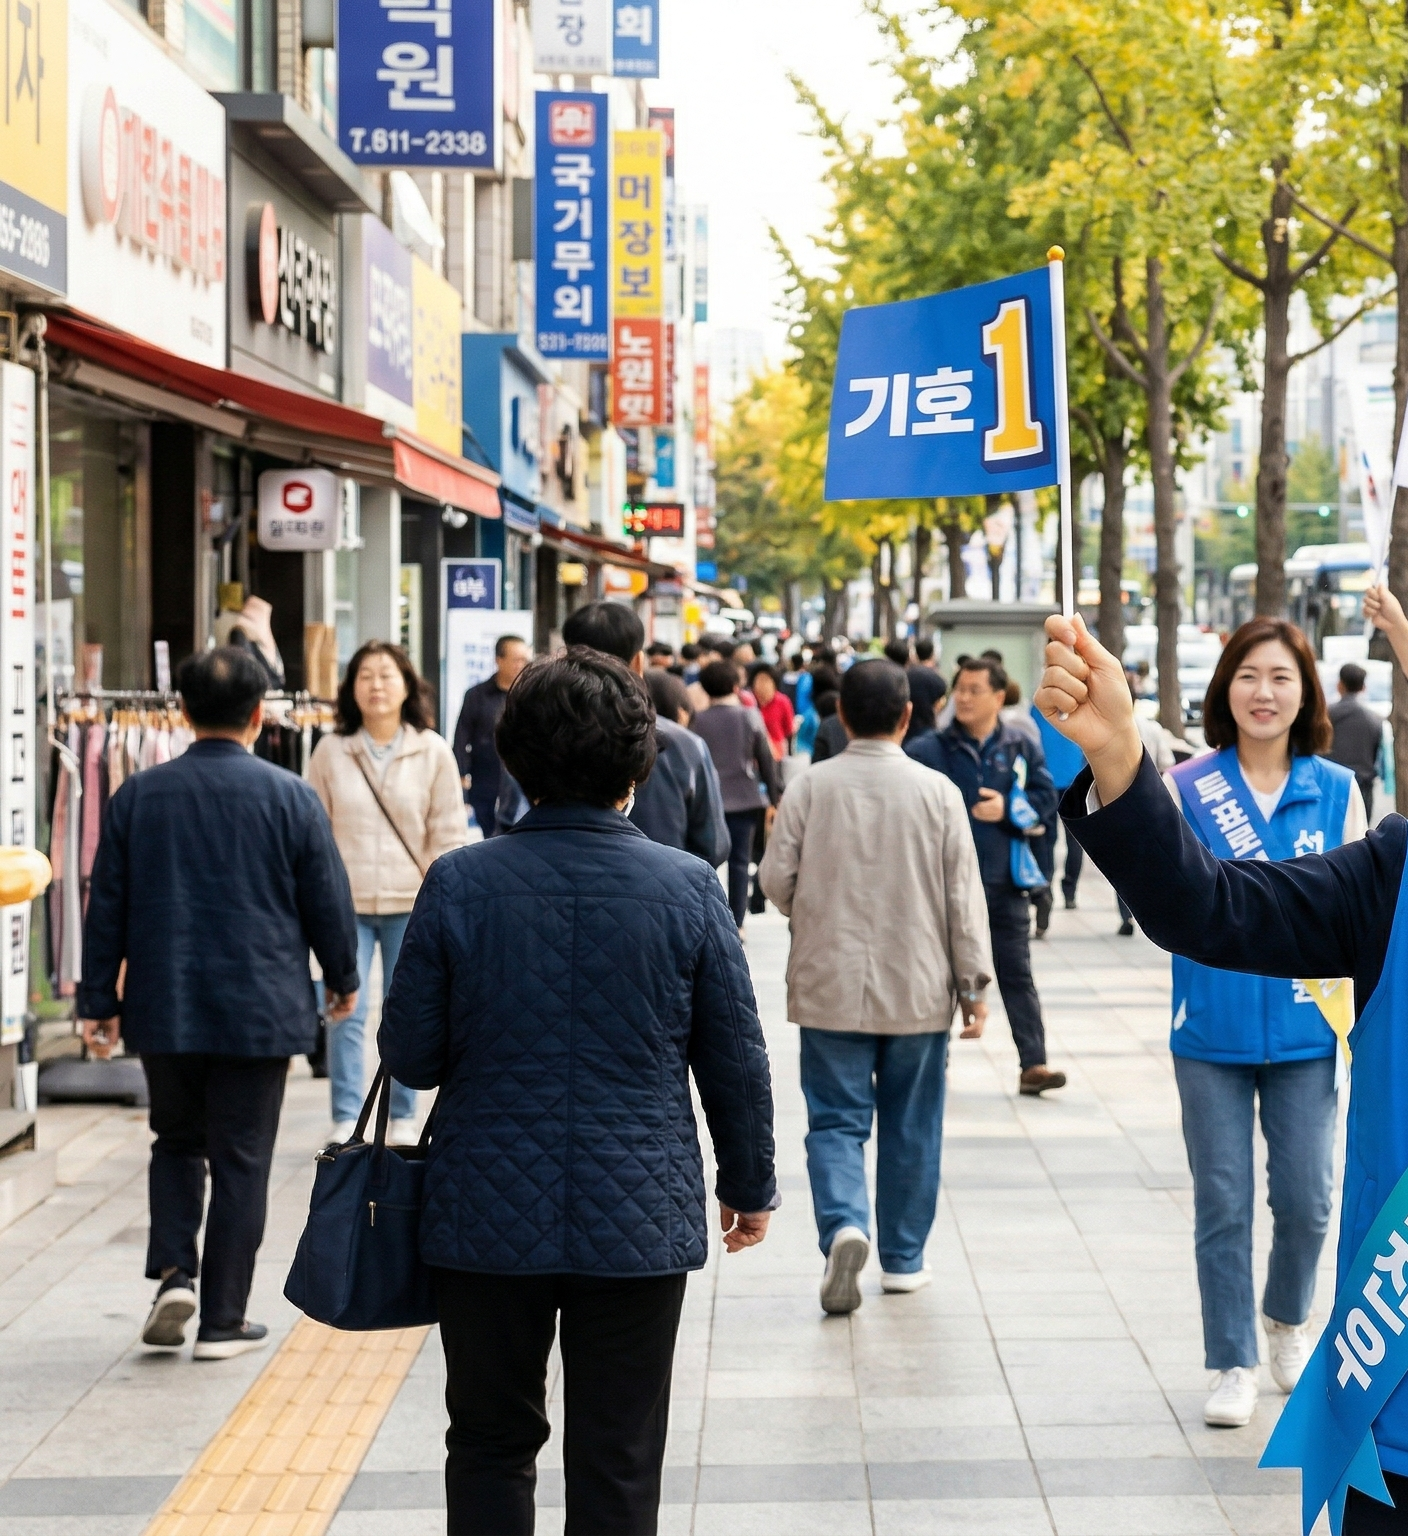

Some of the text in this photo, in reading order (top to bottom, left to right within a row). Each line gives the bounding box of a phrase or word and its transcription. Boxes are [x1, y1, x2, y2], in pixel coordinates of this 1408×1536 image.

[349, 127, 487, 156] T.611-2338
[845, 297, 1045, 464] 기호 1
